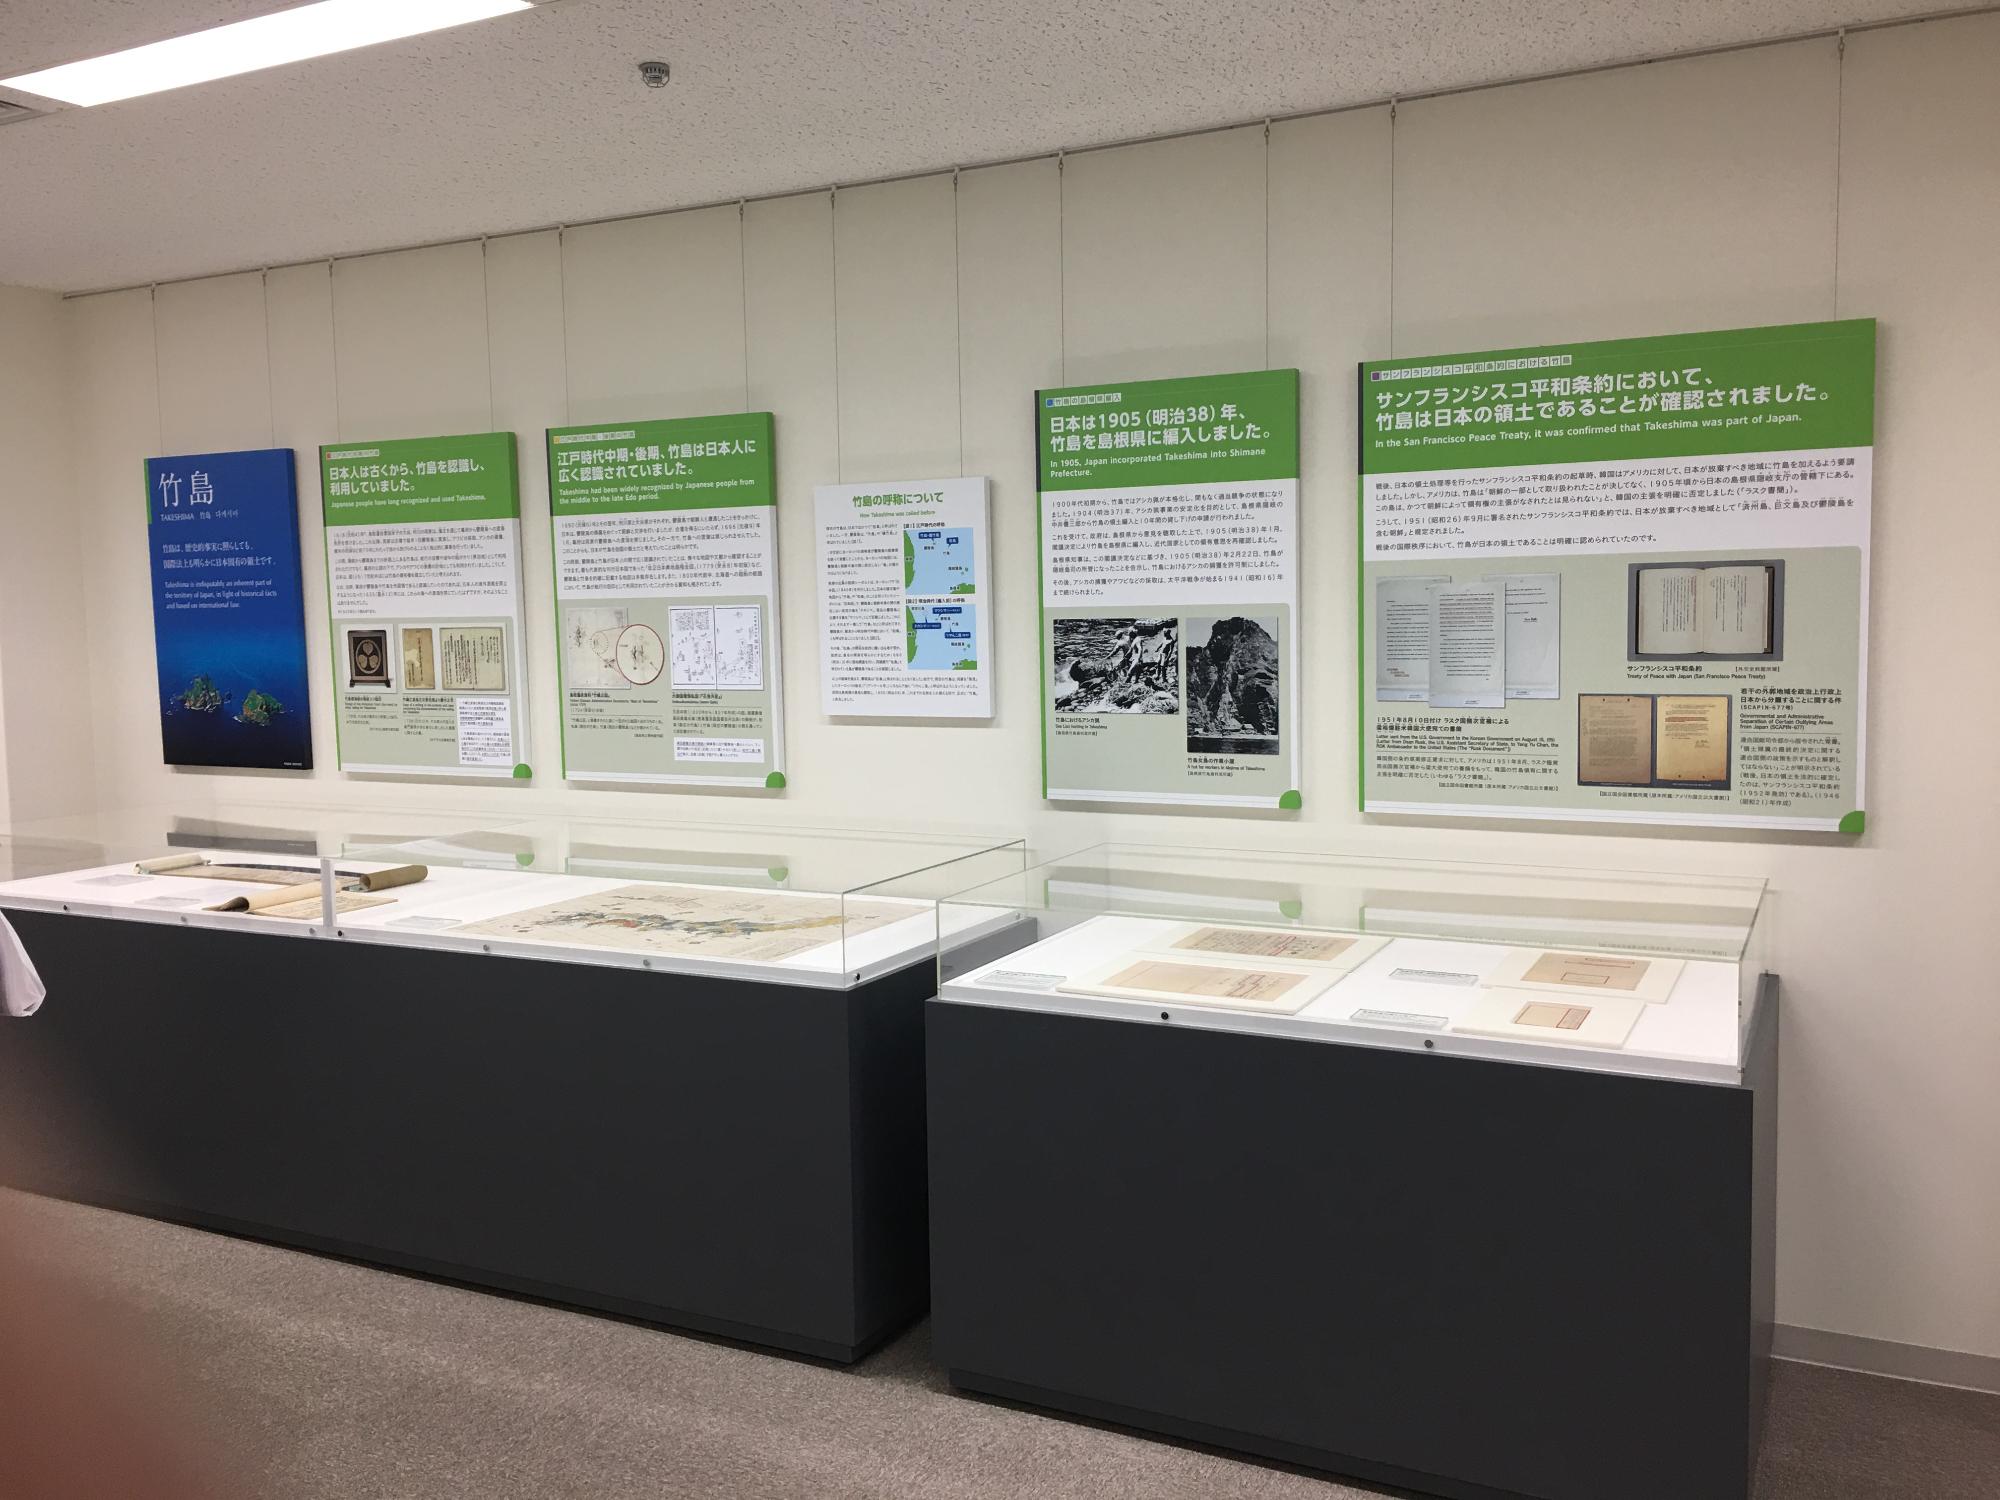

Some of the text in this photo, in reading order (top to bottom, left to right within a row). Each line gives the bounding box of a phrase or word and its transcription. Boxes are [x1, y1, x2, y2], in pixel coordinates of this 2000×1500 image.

[1382, 355, 1571, 379] サンフランシスコ平和条約における竹島
[1376, 364, 1713, 410] サンフランシスコ平和条約において、
[1375, 379, 1828, 431] 竹島は日本の領土であることが確認されました。
[1050, 421, 1270, 453] 竹島を島根県に編入しました。
[1375, 411, 1802, 448] In the San Francisco Peace Treaty, it was confirmed that Takeshima was part of Japan.
[556, 438, 756, 466] 江戸時代中期・後期、竹島は日本人に
[1084, 456, 1107, 466] Japan
[1109, 453, 1162, 465] incorporated
[1164, 450, 1208, 460] Takeshima
[1210, 449, 1227, 458] into
[1229, 446, 1266, 456] Shimane
[328, 457, 486, 480] 日本人は古くから、竹島を認識し、
[557, 460, 693, 483] 広く認識されていました。
[1050, 468, 1093, 478] Prefecture.
[157, 469, 214, 507] 竹島
[329, 478, 415, 496] 利用していました。
[590, 486, 601, 494] had
[602, 485, 618, 493] been
[619, 484, 639, 493] widely
[675, 481, 683, 490] by
[684, 479, 714, 489] Japanese
[715, 478, 737, 487] people
[739, 477, 754, 485] from
[852, 491, 944, 508] 竹島の呼称について
[160, 511, 194, 521] TAKESHIMA
